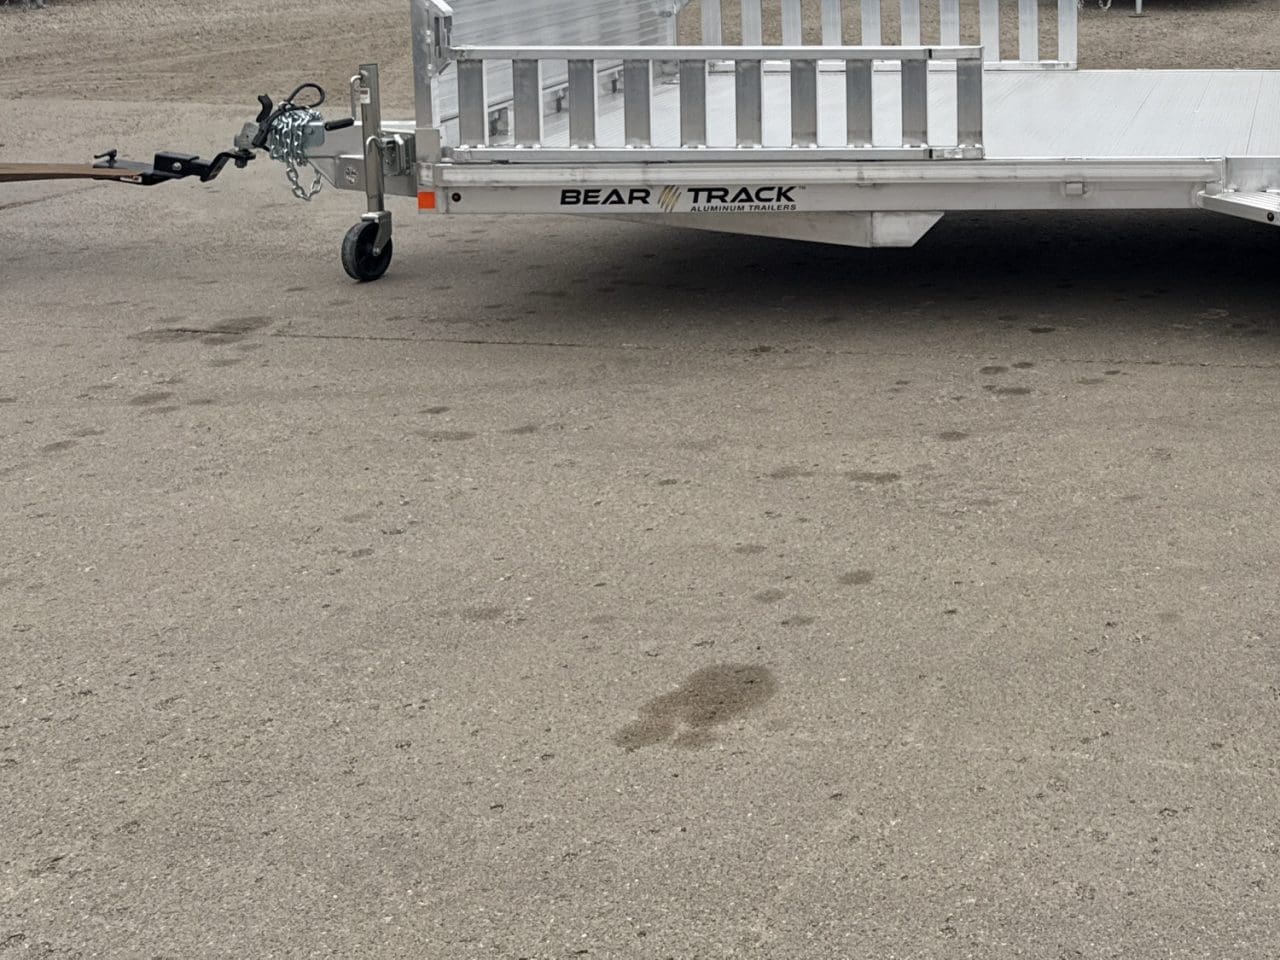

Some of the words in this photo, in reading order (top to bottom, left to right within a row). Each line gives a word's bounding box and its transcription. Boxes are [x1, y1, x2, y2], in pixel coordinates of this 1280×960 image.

[560, 188, 650, 206] BEAR
[690, 204, 745, 213] ALUMINUM
[749, 203, 797, 212] TRAILERS
